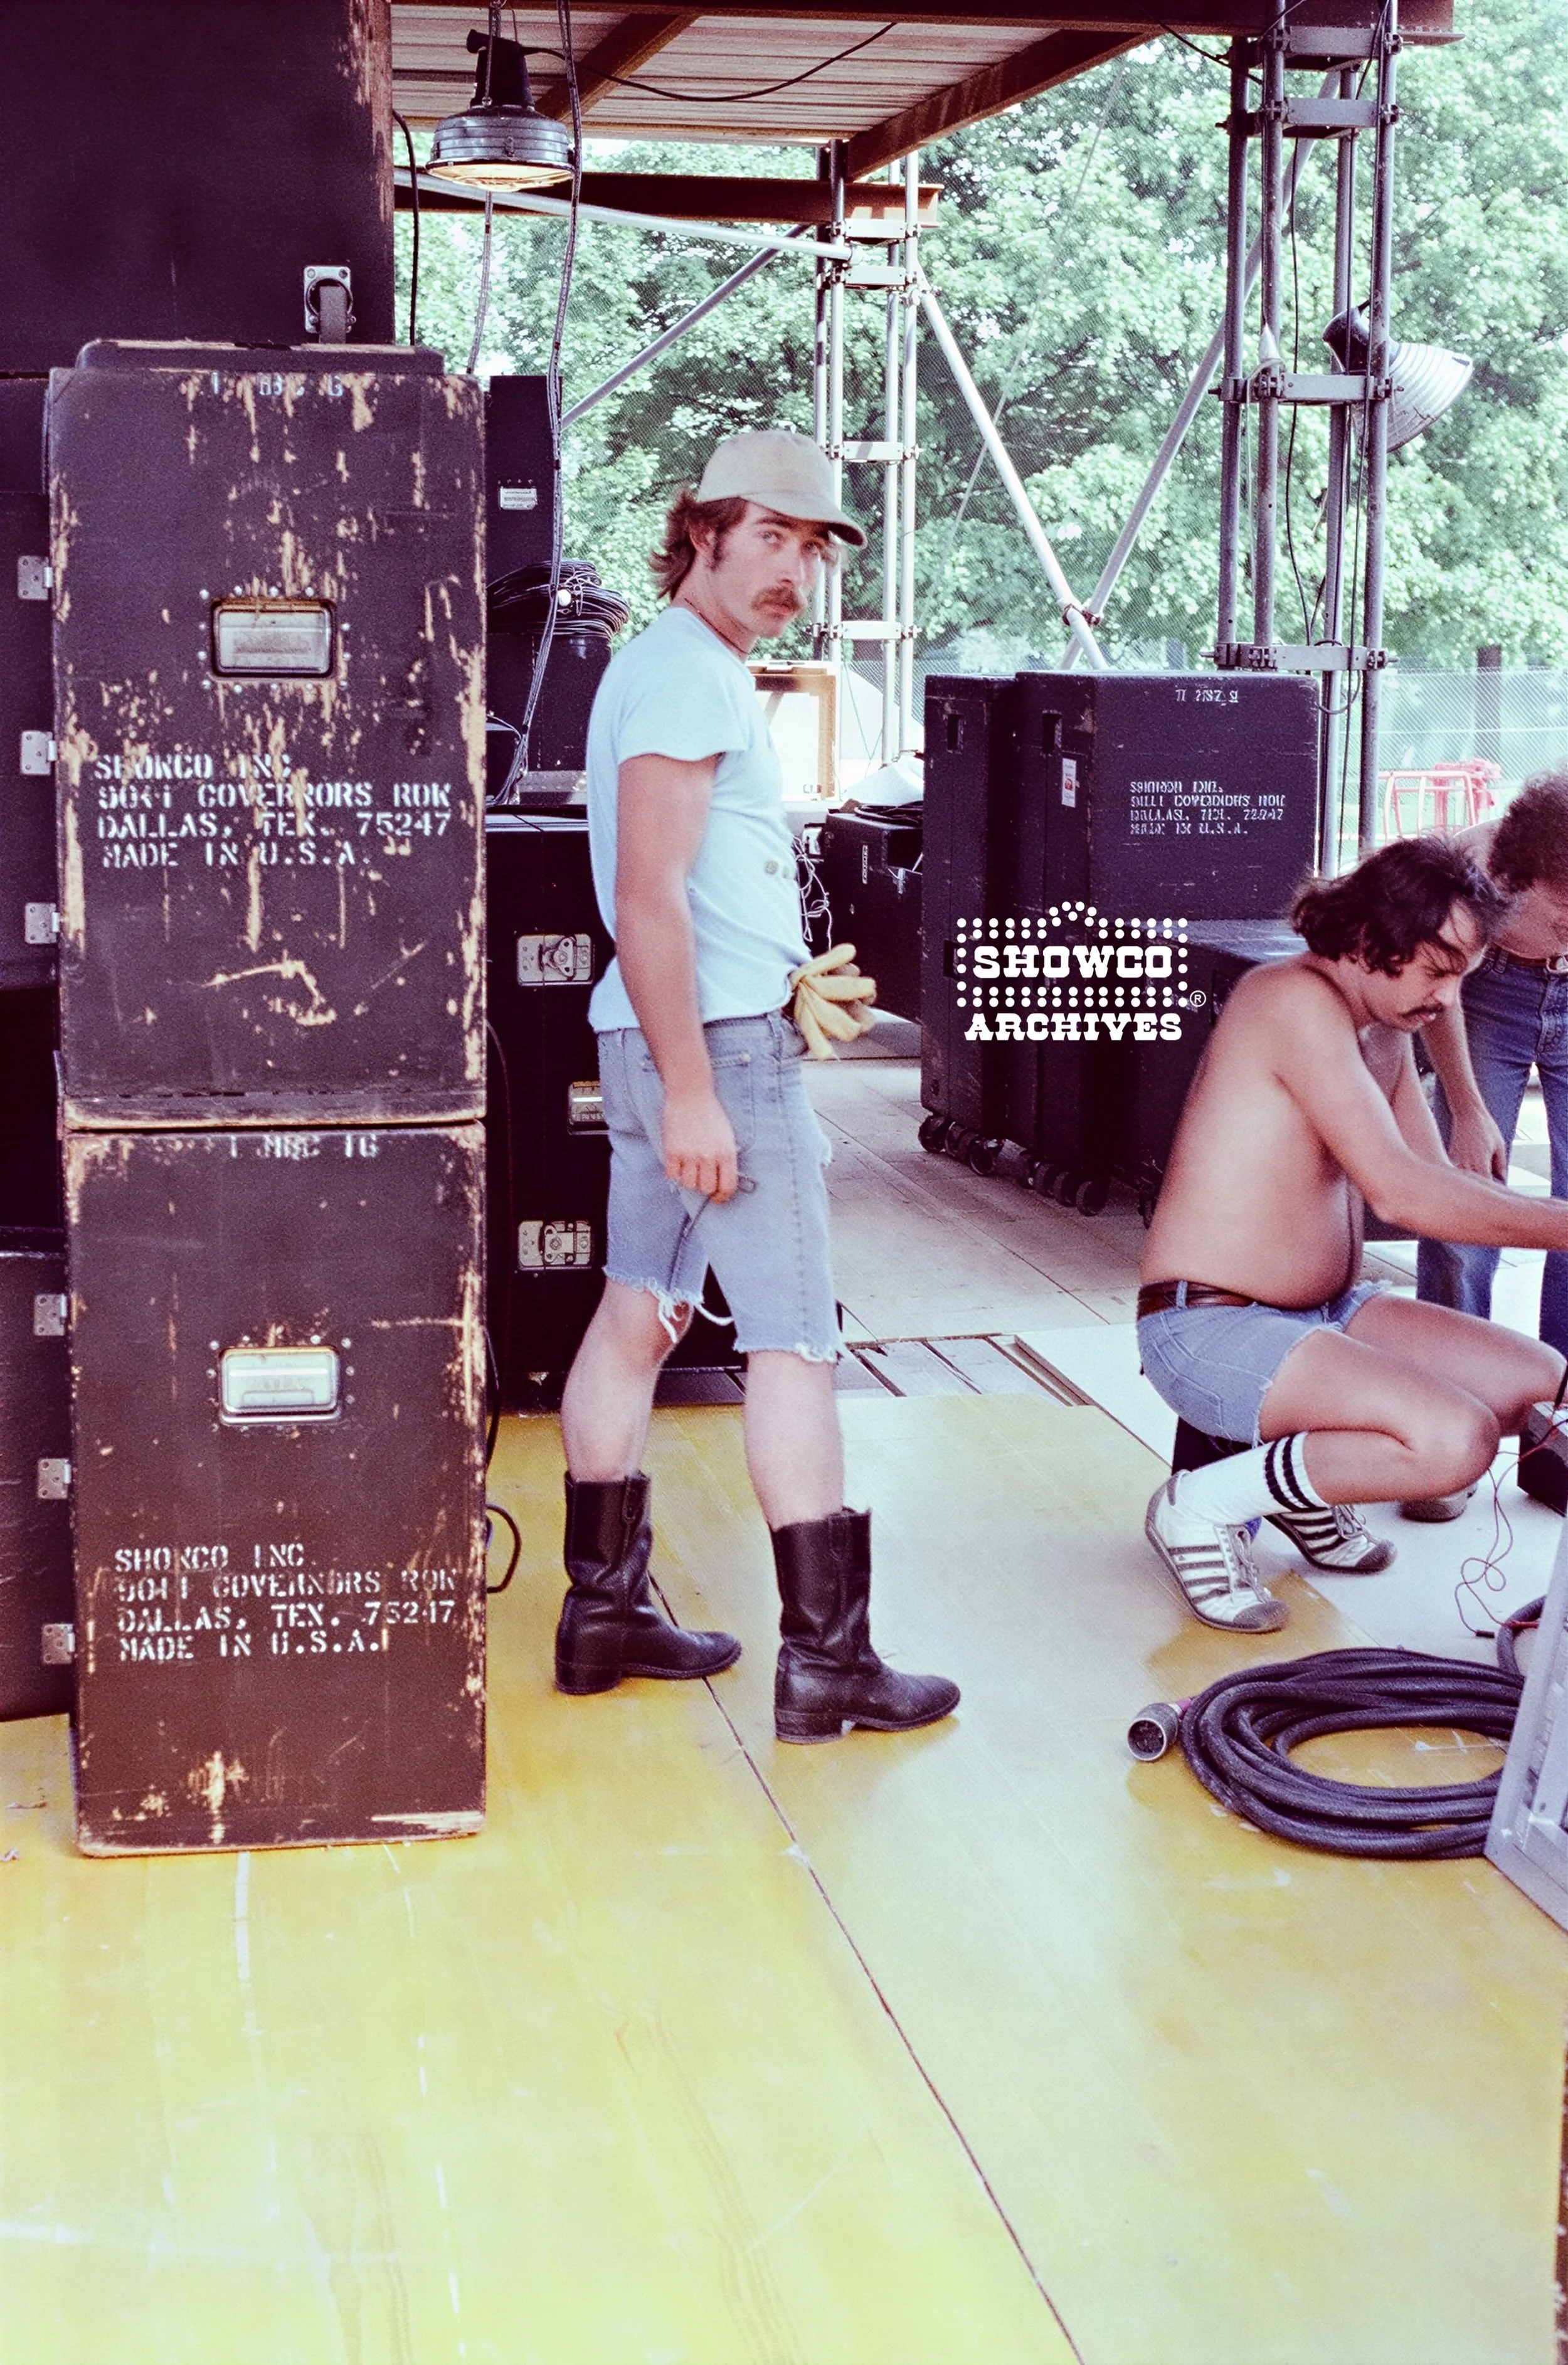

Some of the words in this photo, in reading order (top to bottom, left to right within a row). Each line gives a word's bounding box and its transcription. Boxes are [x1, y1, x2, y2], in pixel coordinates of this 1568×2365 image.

[356, 811, 451, 837] 75247
[102, 841, 179, 869] MADE
[204, 841, 239, 866] IN
[270, 1602, 340, 1629] TEX.
[119, 1634, 194, 1662] MADE
[220, 1632, 252, 1658] IN
[270, 1629, 380, 1655] U.S.A.
